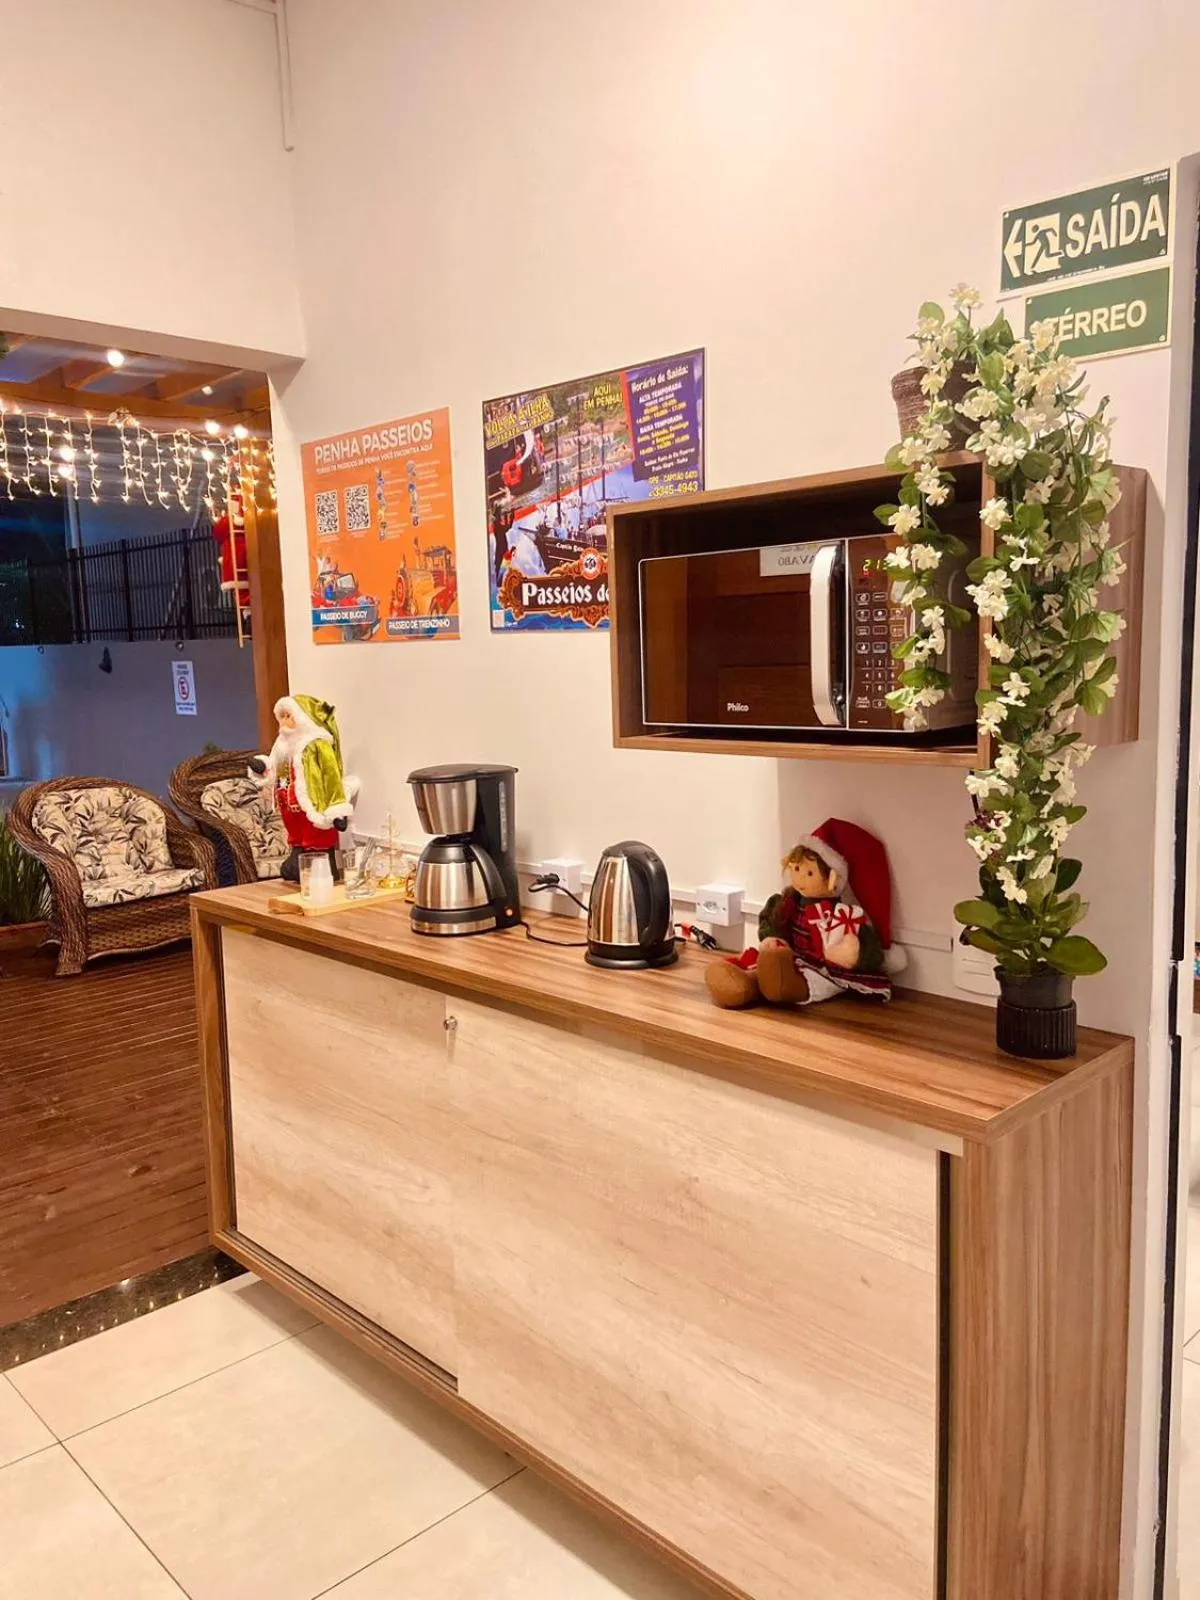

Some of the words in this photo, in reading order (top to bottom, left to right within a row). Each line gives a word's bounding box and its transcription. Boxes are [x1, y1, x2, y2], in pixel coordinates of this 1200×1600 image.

[1065, 193, 1166, 258] SAÍDA
[594, 384, 611, 396] AQUI
[314, 435, 361, 465] PENHA
[362, 418, 433, 455] PASSEIOS
[522, 581, 593, 606] Passeios
[727, 702, 750, 712] Philco
